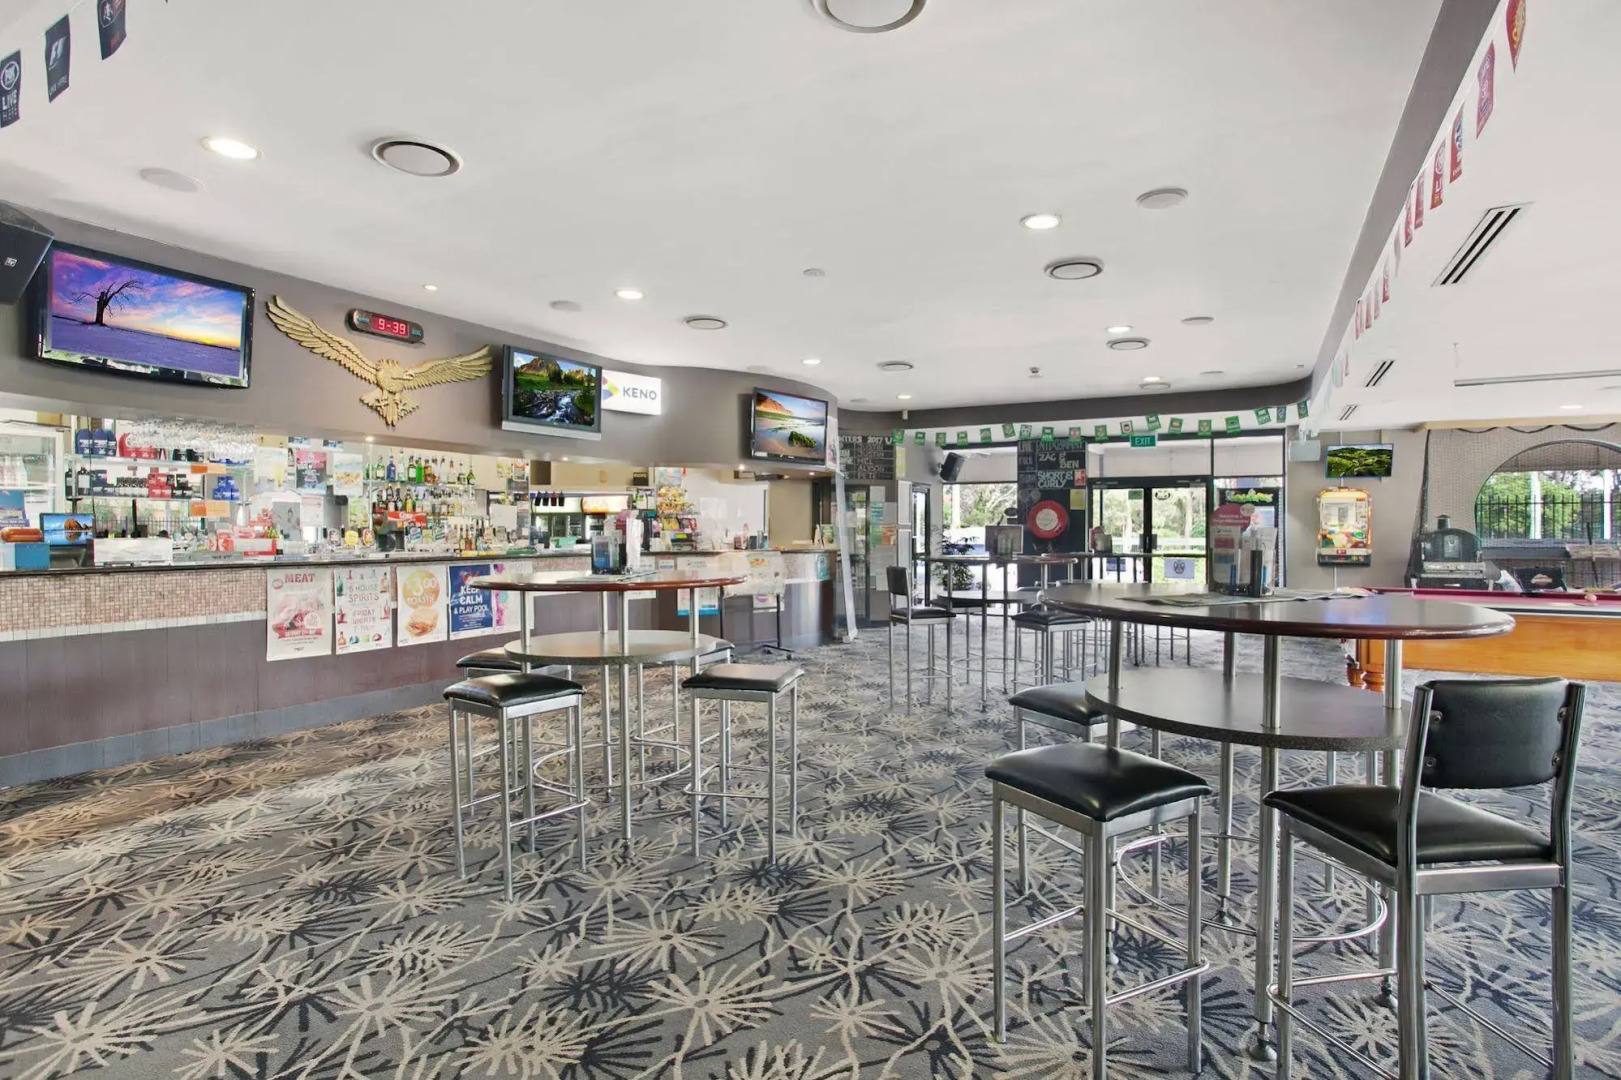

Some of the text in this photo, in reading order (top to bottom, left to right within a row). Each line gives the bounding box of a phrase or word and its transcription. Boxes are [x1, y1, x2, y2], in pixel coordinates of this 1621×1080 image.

[2, 89, 17, 110] LIVE
[623, 386, 657, 400] KENO
[867, 436, 884, 444] 2017
[1135, 436, 1152, 446] EXIT
[1060, 460, 1080, 469] BEN
[1037, 470, 1065, 480] SHORT
[1037, 479, 1067, 488] CURLY
[285, 573, 315, 583] MEAT
[348, 593, 380, 603] SPIRITS
[459, 594, 483, 605] CALM
[459, 606, 473, 614] PLAY
[474, 604, 489, 612] POOL
